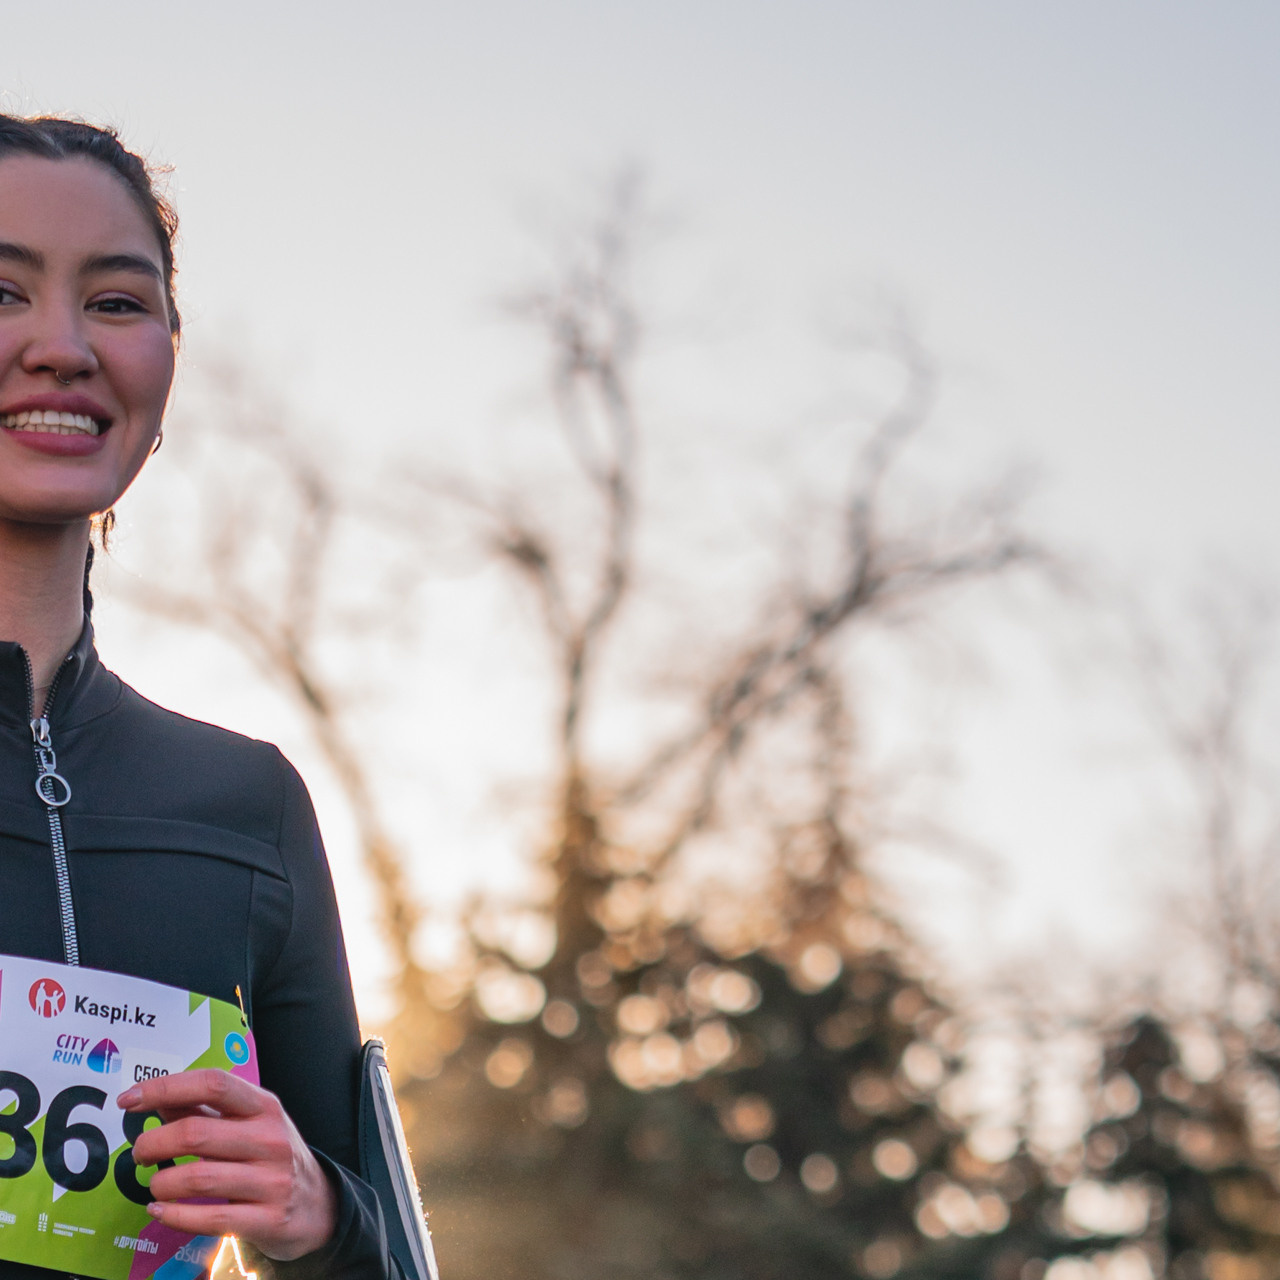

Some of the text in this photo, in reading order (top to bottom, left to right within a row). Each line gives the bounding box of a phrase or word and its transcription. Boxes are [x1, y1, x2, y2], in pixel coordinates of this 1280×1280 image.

[74, 995, 156, 1028] Kaspi.kz
[56, 1033, 90, 1052] CITY
[52, 1050, 83, 1066] RUN
[113, 1235, 159, 1255] #ДРУГОЙТЫ
